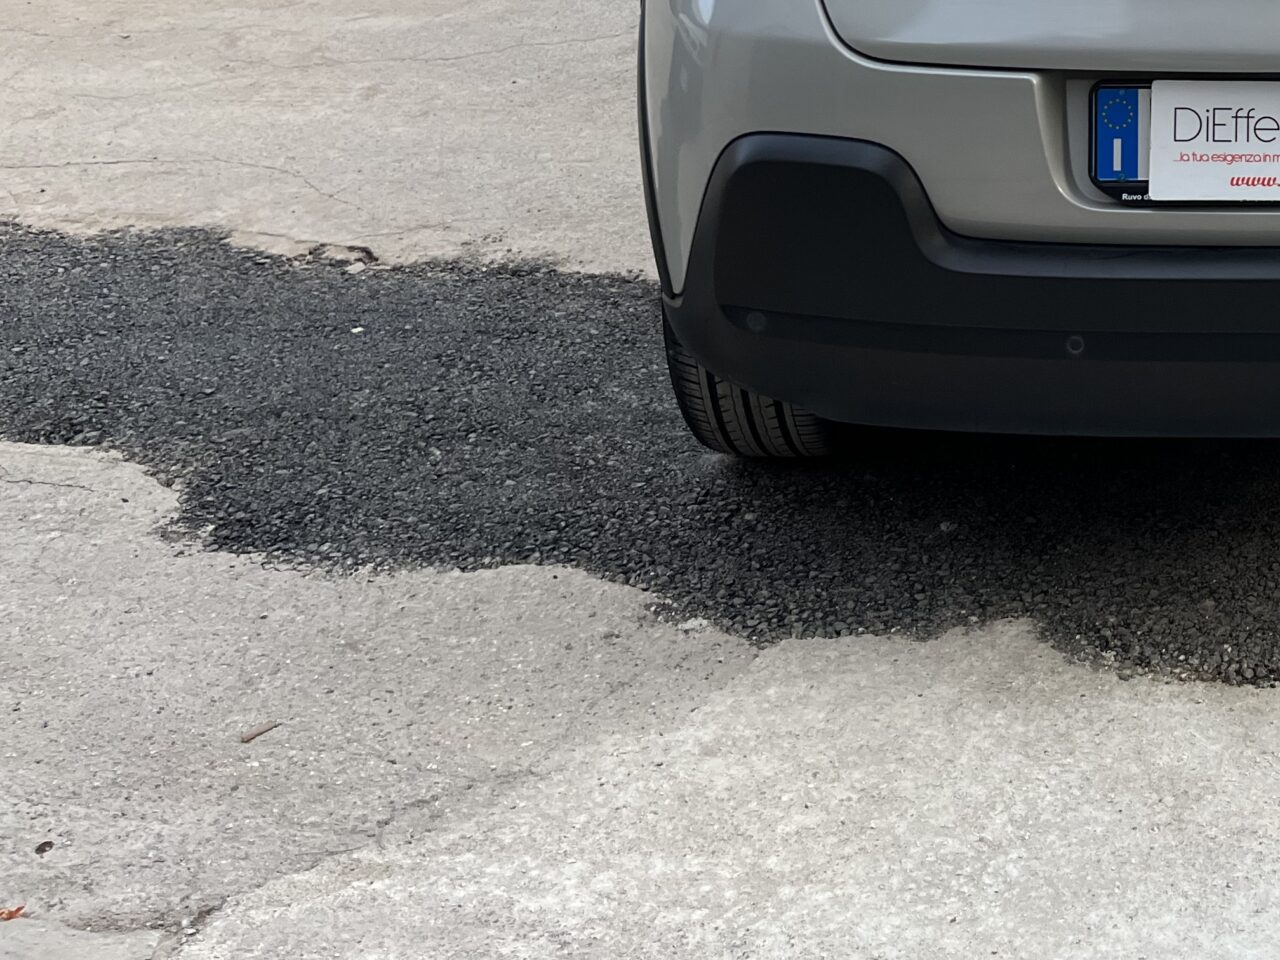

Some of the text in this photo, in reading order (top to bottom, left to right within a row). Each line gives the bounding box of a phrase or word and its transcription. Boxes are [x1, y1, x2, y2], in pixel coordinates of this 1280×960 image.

[1174, 107, 1280, 143] DiEffe
[1113, 138, 1122, 171] I
[1192, 152, 1209, 162] tua
[1211, 152, 1261, 165] esigenza
[1263, 152, 1271, 162] in
